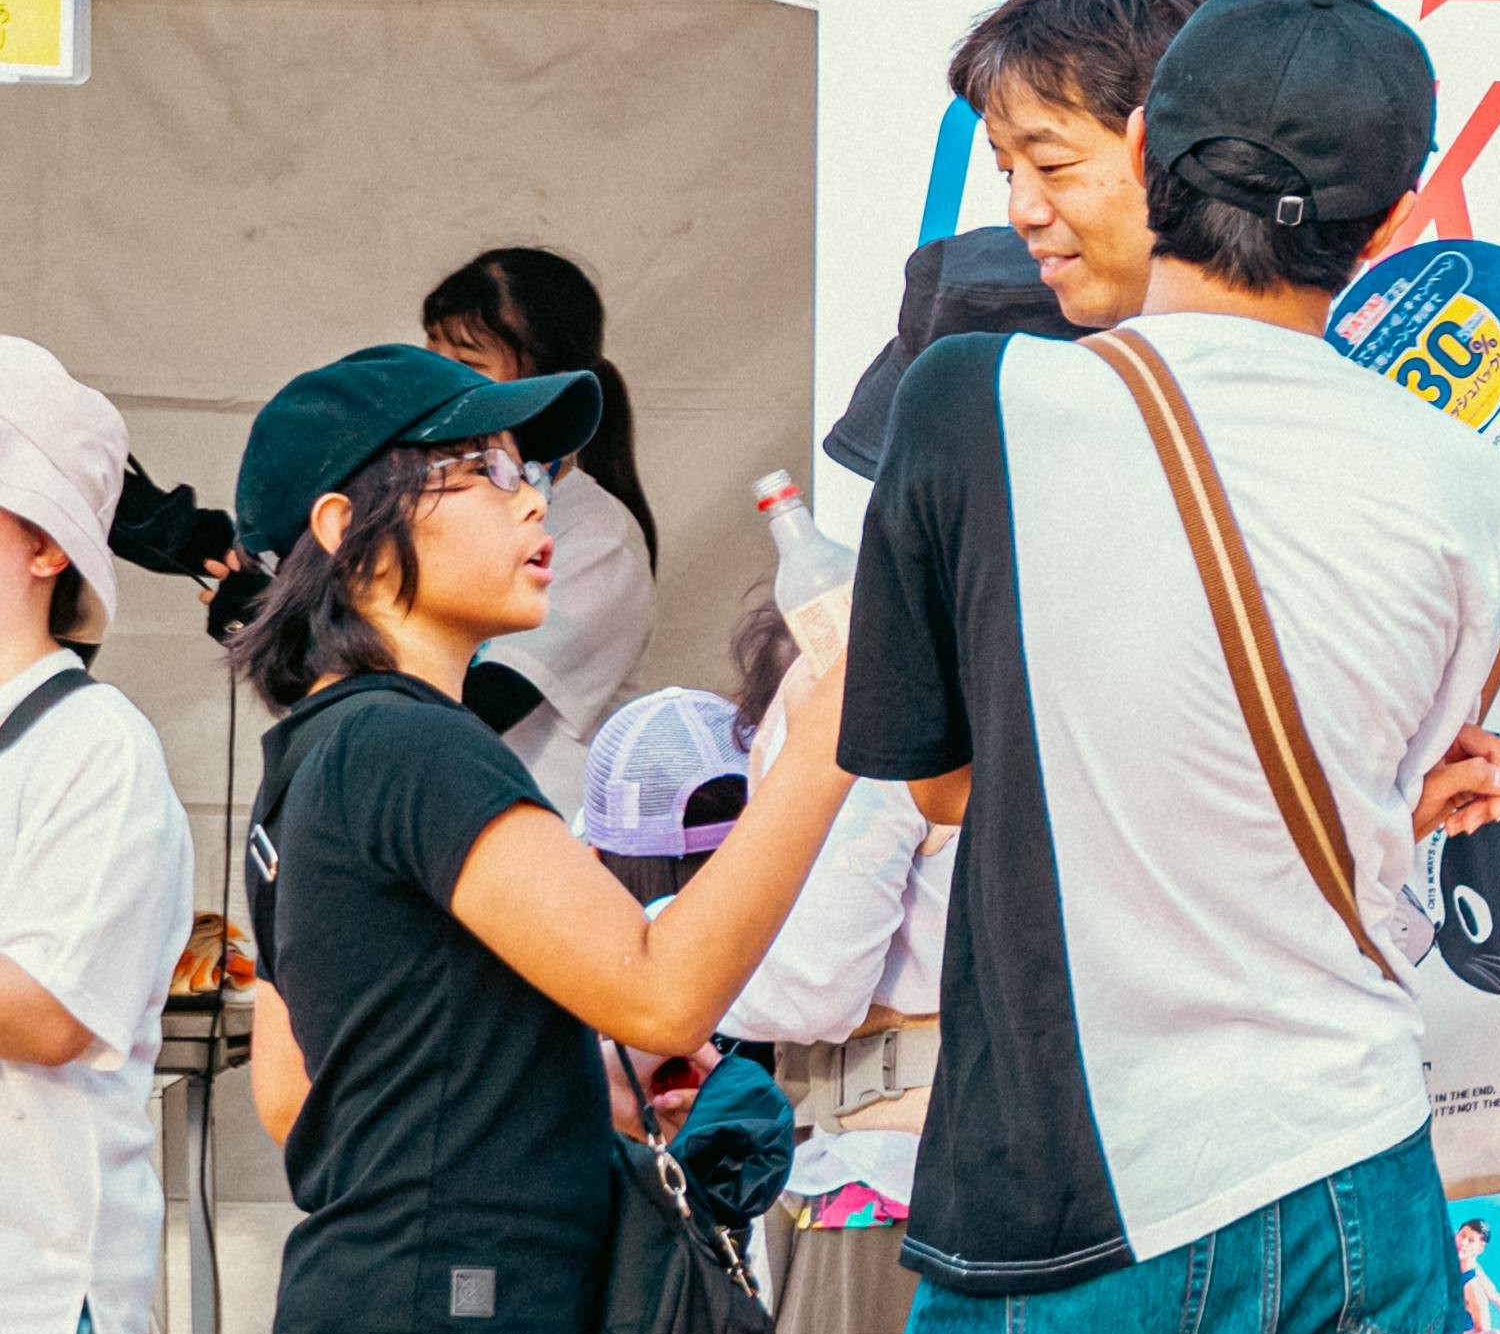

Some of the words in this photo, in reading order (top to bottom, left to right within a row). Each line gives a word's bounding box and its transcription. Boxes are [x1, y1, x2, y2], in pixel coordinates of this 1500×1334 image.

[1434, 1093, 1447, 1103] IN
[1449, 1089, 1470, 1102] THE
[1457, 1100, 1478, 1113] NOT
